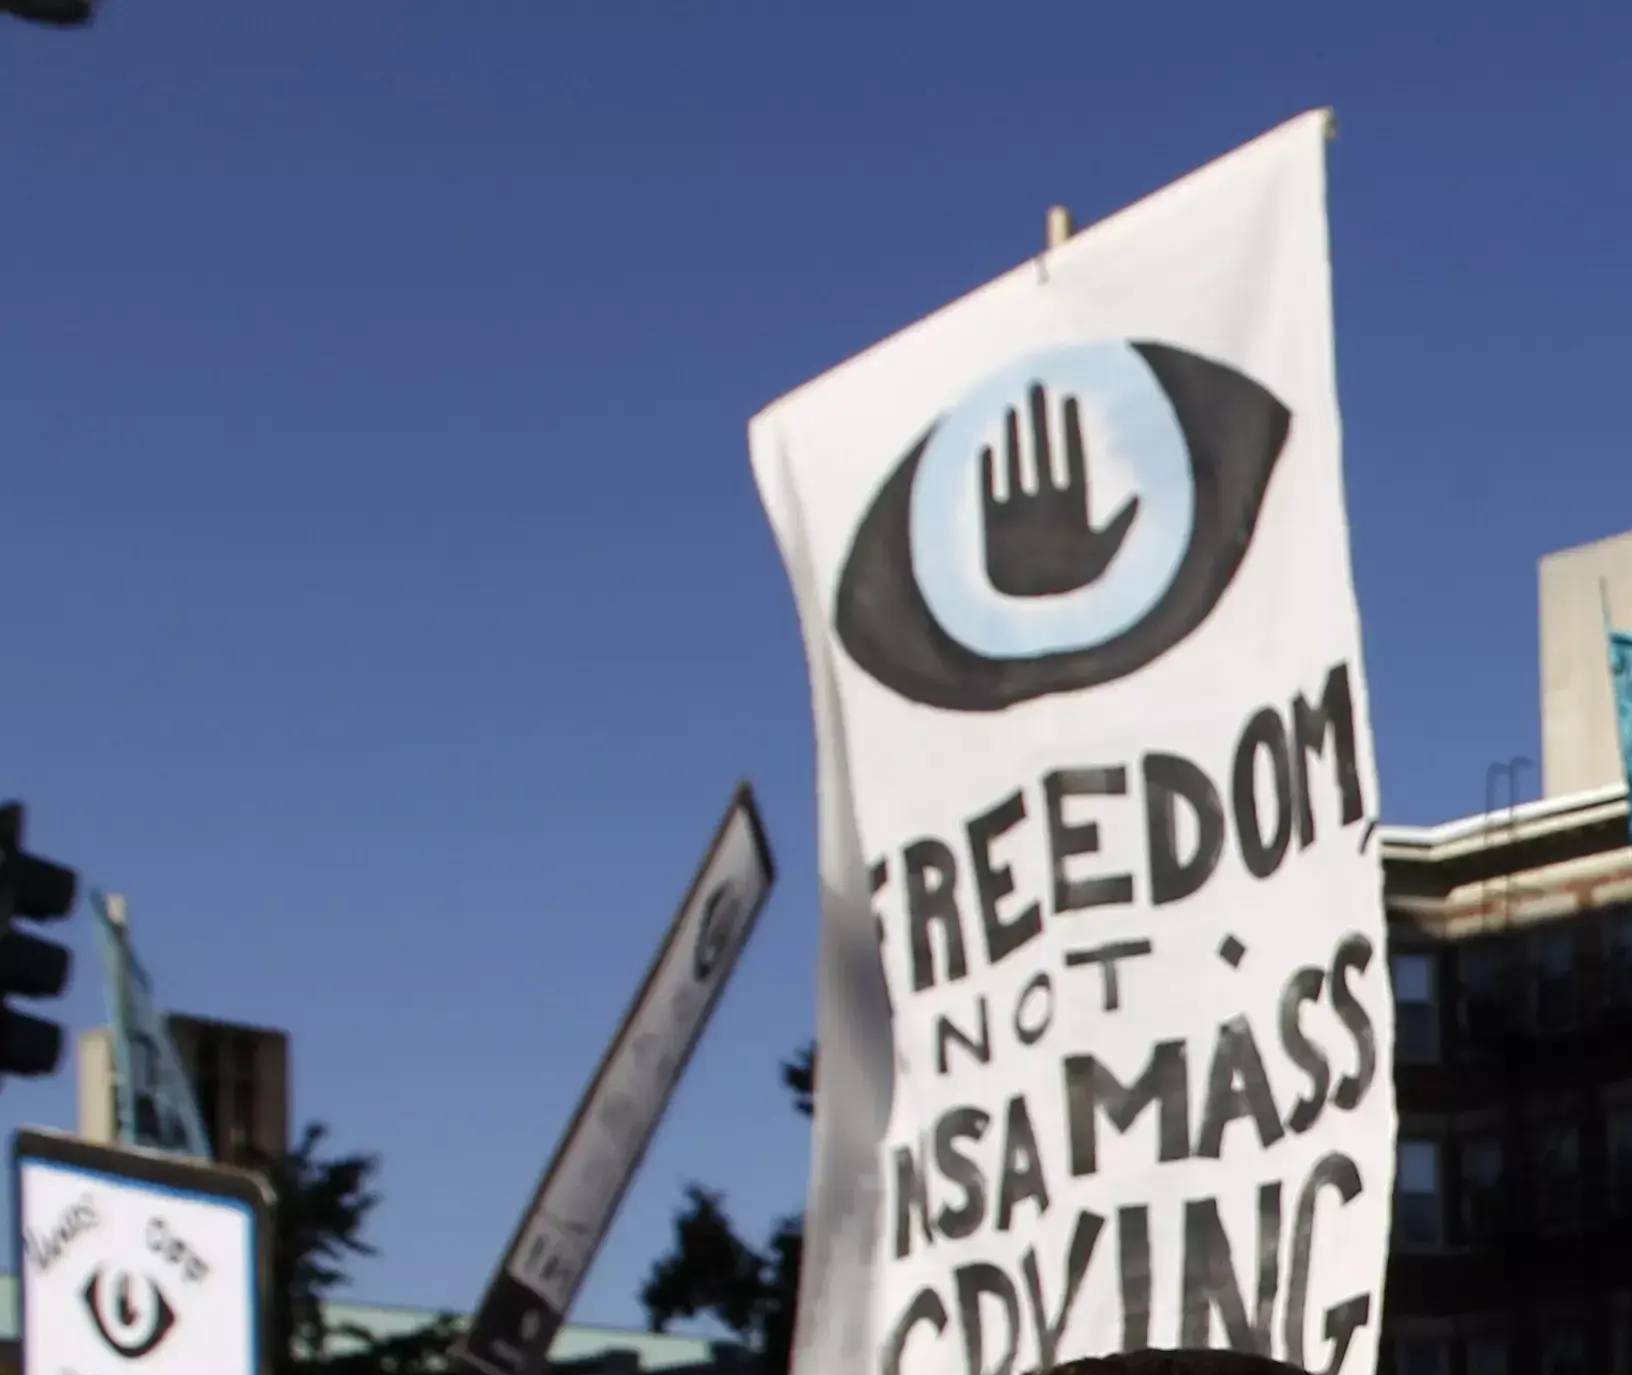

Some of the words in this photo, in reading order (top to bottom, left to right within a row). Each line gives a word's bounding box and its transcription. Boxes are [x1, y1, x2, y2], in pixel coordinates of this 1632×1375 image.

[892, 1092, 1050, 1262] NSA
[1063, 932, 1376, 1178] MASS
[935, 935, 1152, 1077] NOT
